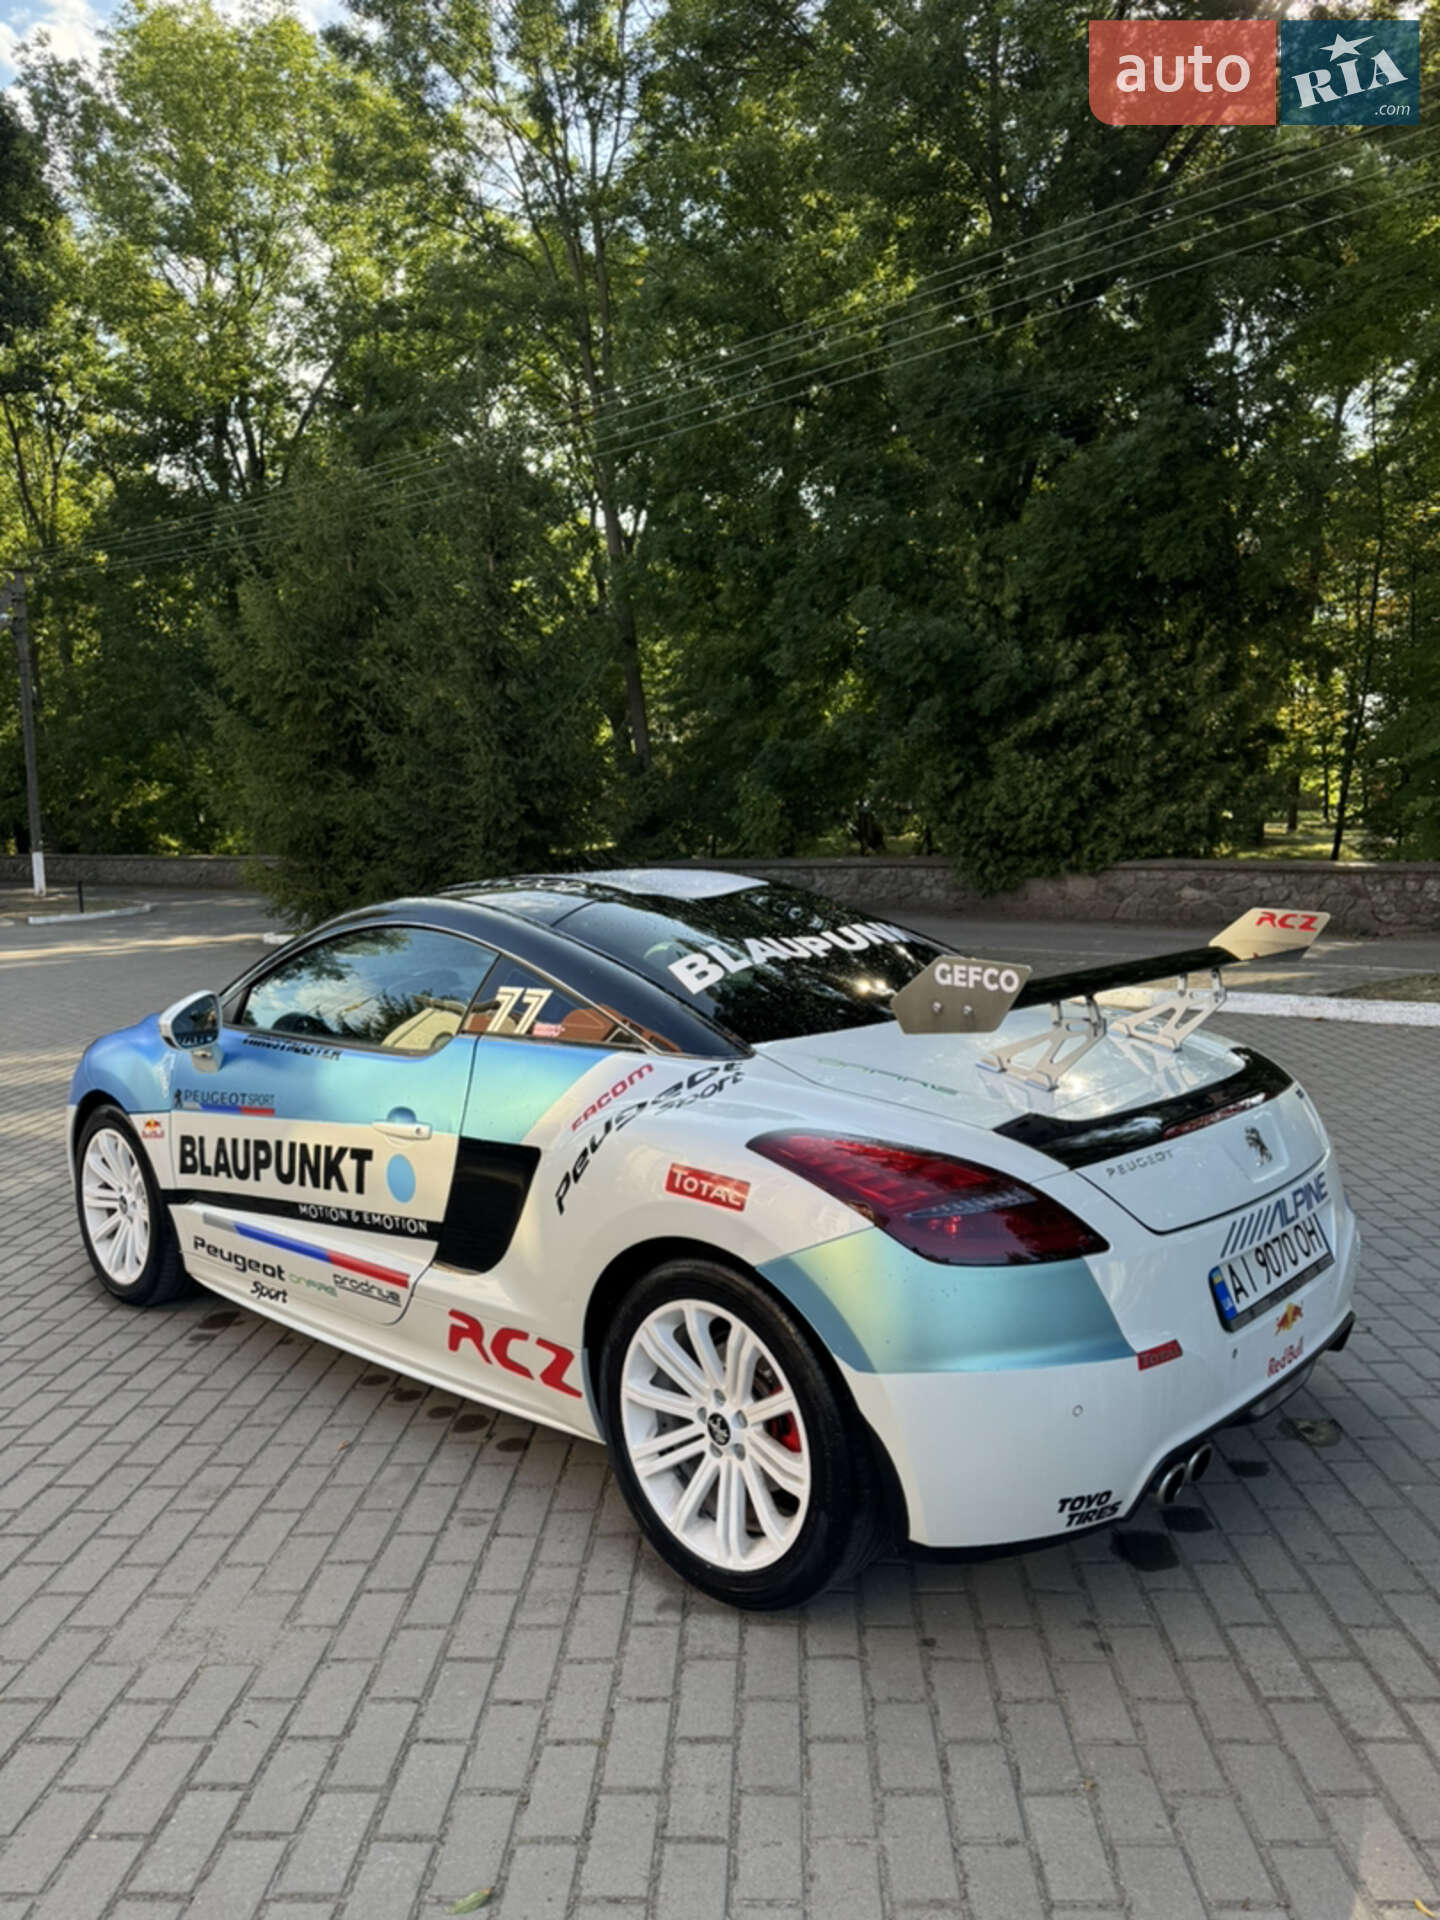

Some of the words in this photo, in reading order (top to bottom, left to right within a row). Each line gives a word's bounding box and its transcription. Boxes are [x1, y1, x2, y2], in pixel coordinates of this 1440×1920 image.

[1255, 911, 1318, 932] RCZ
[668, 921, 918, 995] BLAUPUN
[934, 963, 1020, 994] GEFCO
[487, 986, 552, 1035] 77
[179, 1135, 373, 1195] BLAUPUNKT
[1106, 1150, 1174, 1178] PEUGEOT
[671, 1168, 746, 1207] TOTAL
[299, 1205, 347, 1221] MOTION
[363, 1213, 428, 1234] EMOTION
[193, 1236, 286, 1282] Peugeot
[1255, 1231, 1298, 1285] 9070
[250, 1280, 288, 1304] Sport
[448, 1308, 583, 1399] RCZ
[1057, 1490, 1113, 1514] TOYO
[1065, 1500, 1123, 1528] TIRES
